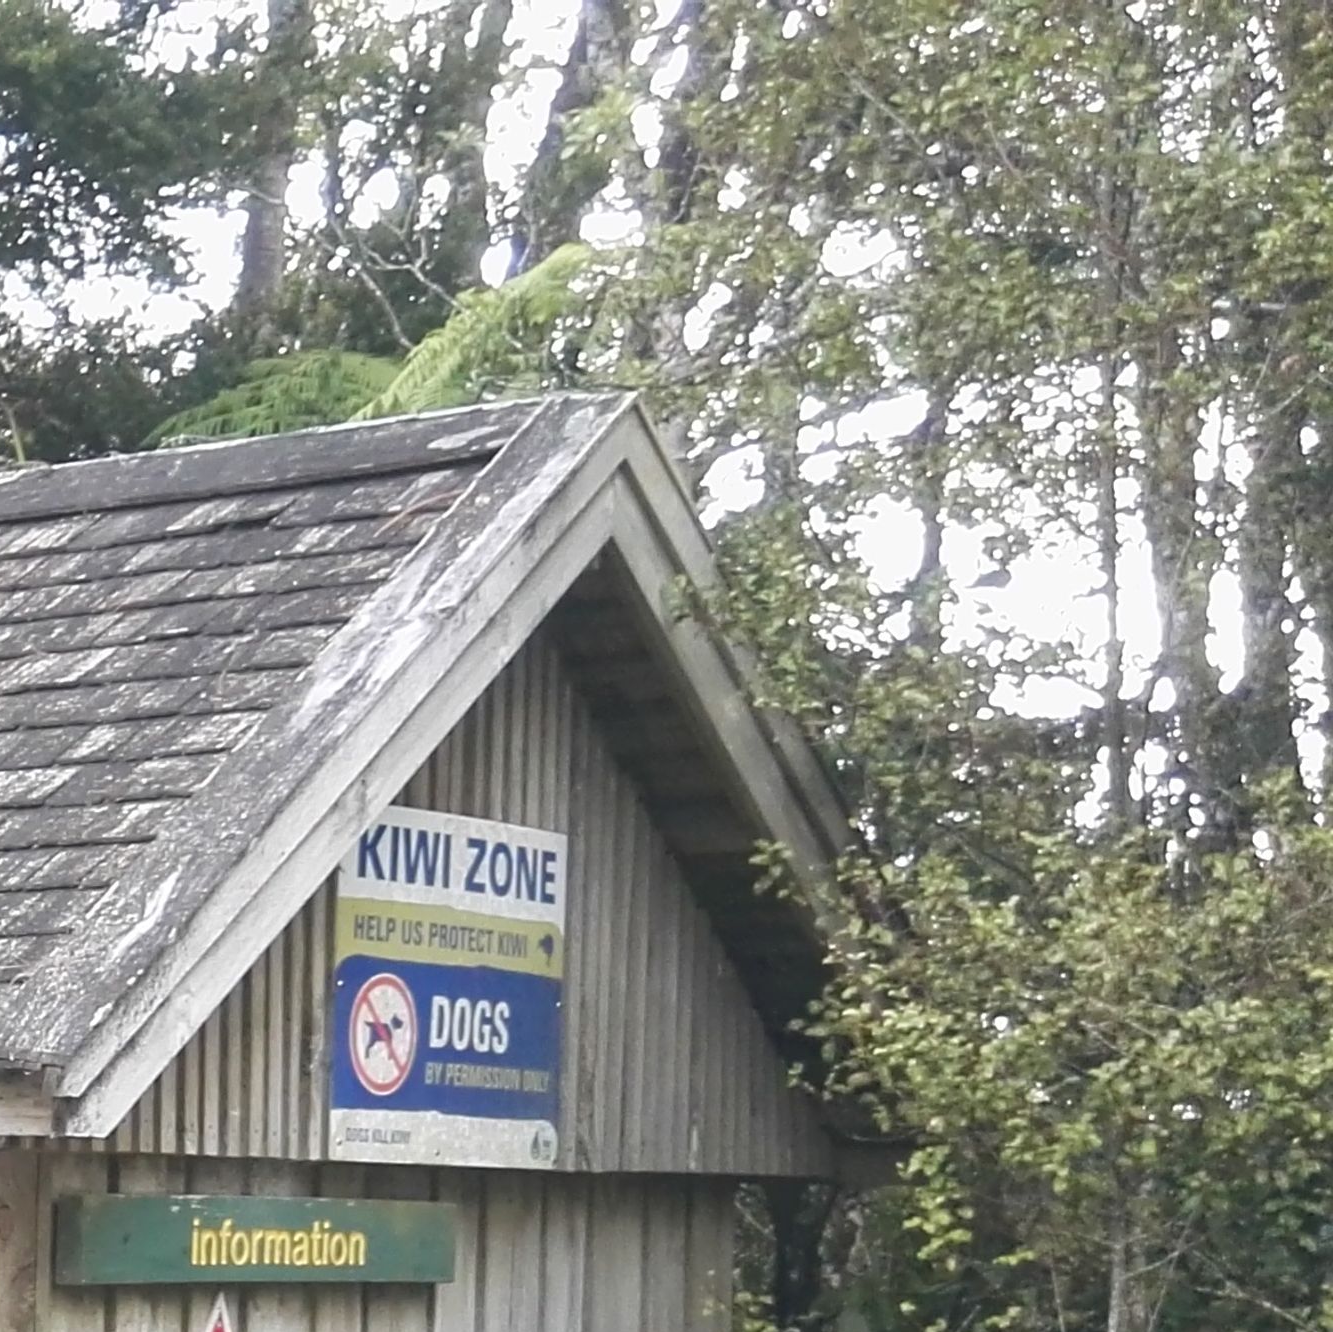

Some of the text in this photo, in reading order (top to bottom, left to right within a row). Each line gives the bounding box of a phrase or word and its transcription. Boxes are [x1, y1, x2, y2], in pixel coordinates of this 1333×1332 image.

[357, 824, 556, 904] KIWI ZONE
[354, 915, 529, 958] HELP US PROTECT KIWI
[429, 995, 509, 1054] DOGS
[425, 1062, 549, 1093] BY PERMISSION ONLY
[190, 1218, 366, 1267] information
